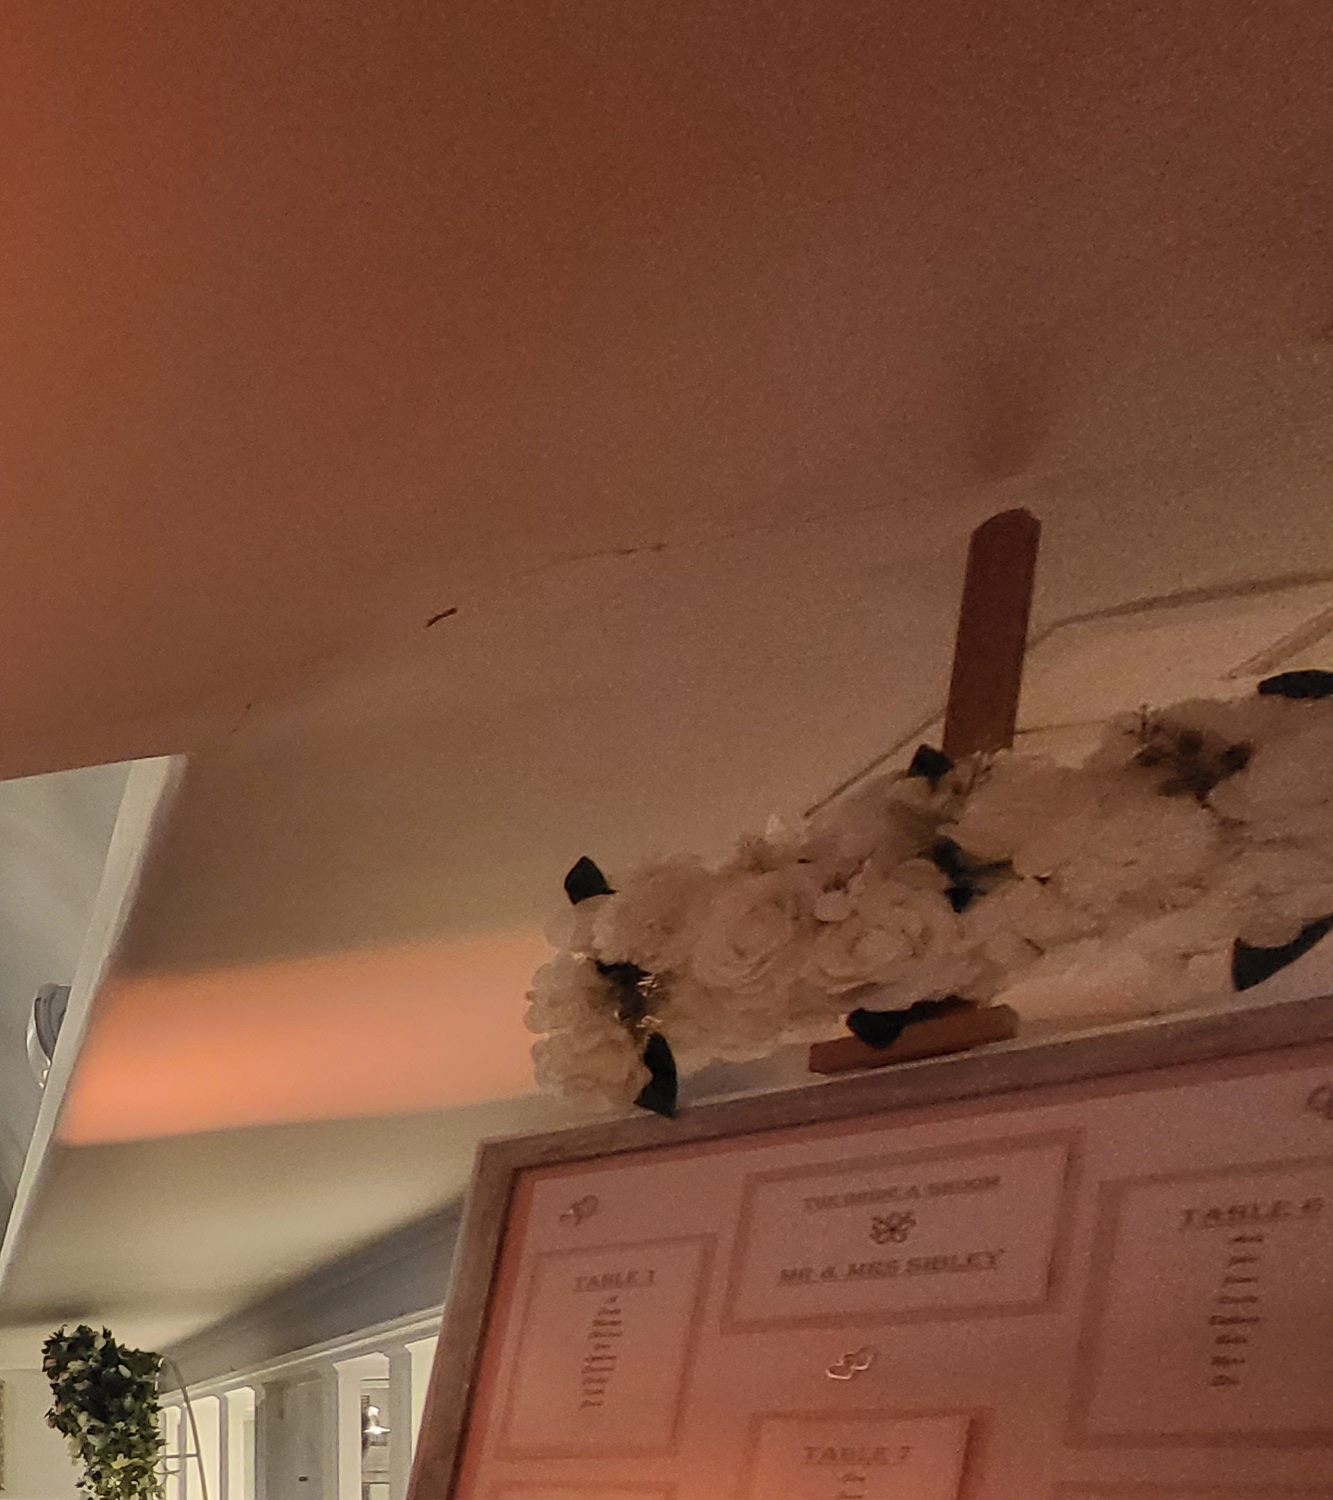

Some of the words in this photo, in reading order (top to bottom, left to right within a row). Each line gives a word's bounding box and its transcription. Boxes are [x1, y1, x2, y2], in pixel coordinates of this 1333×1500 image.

[1183, 1201, 1290, 1226] TABLE
[574, 1271, 638, 1291] TABLE
[804, 1446, 888, 1465] TABLE
